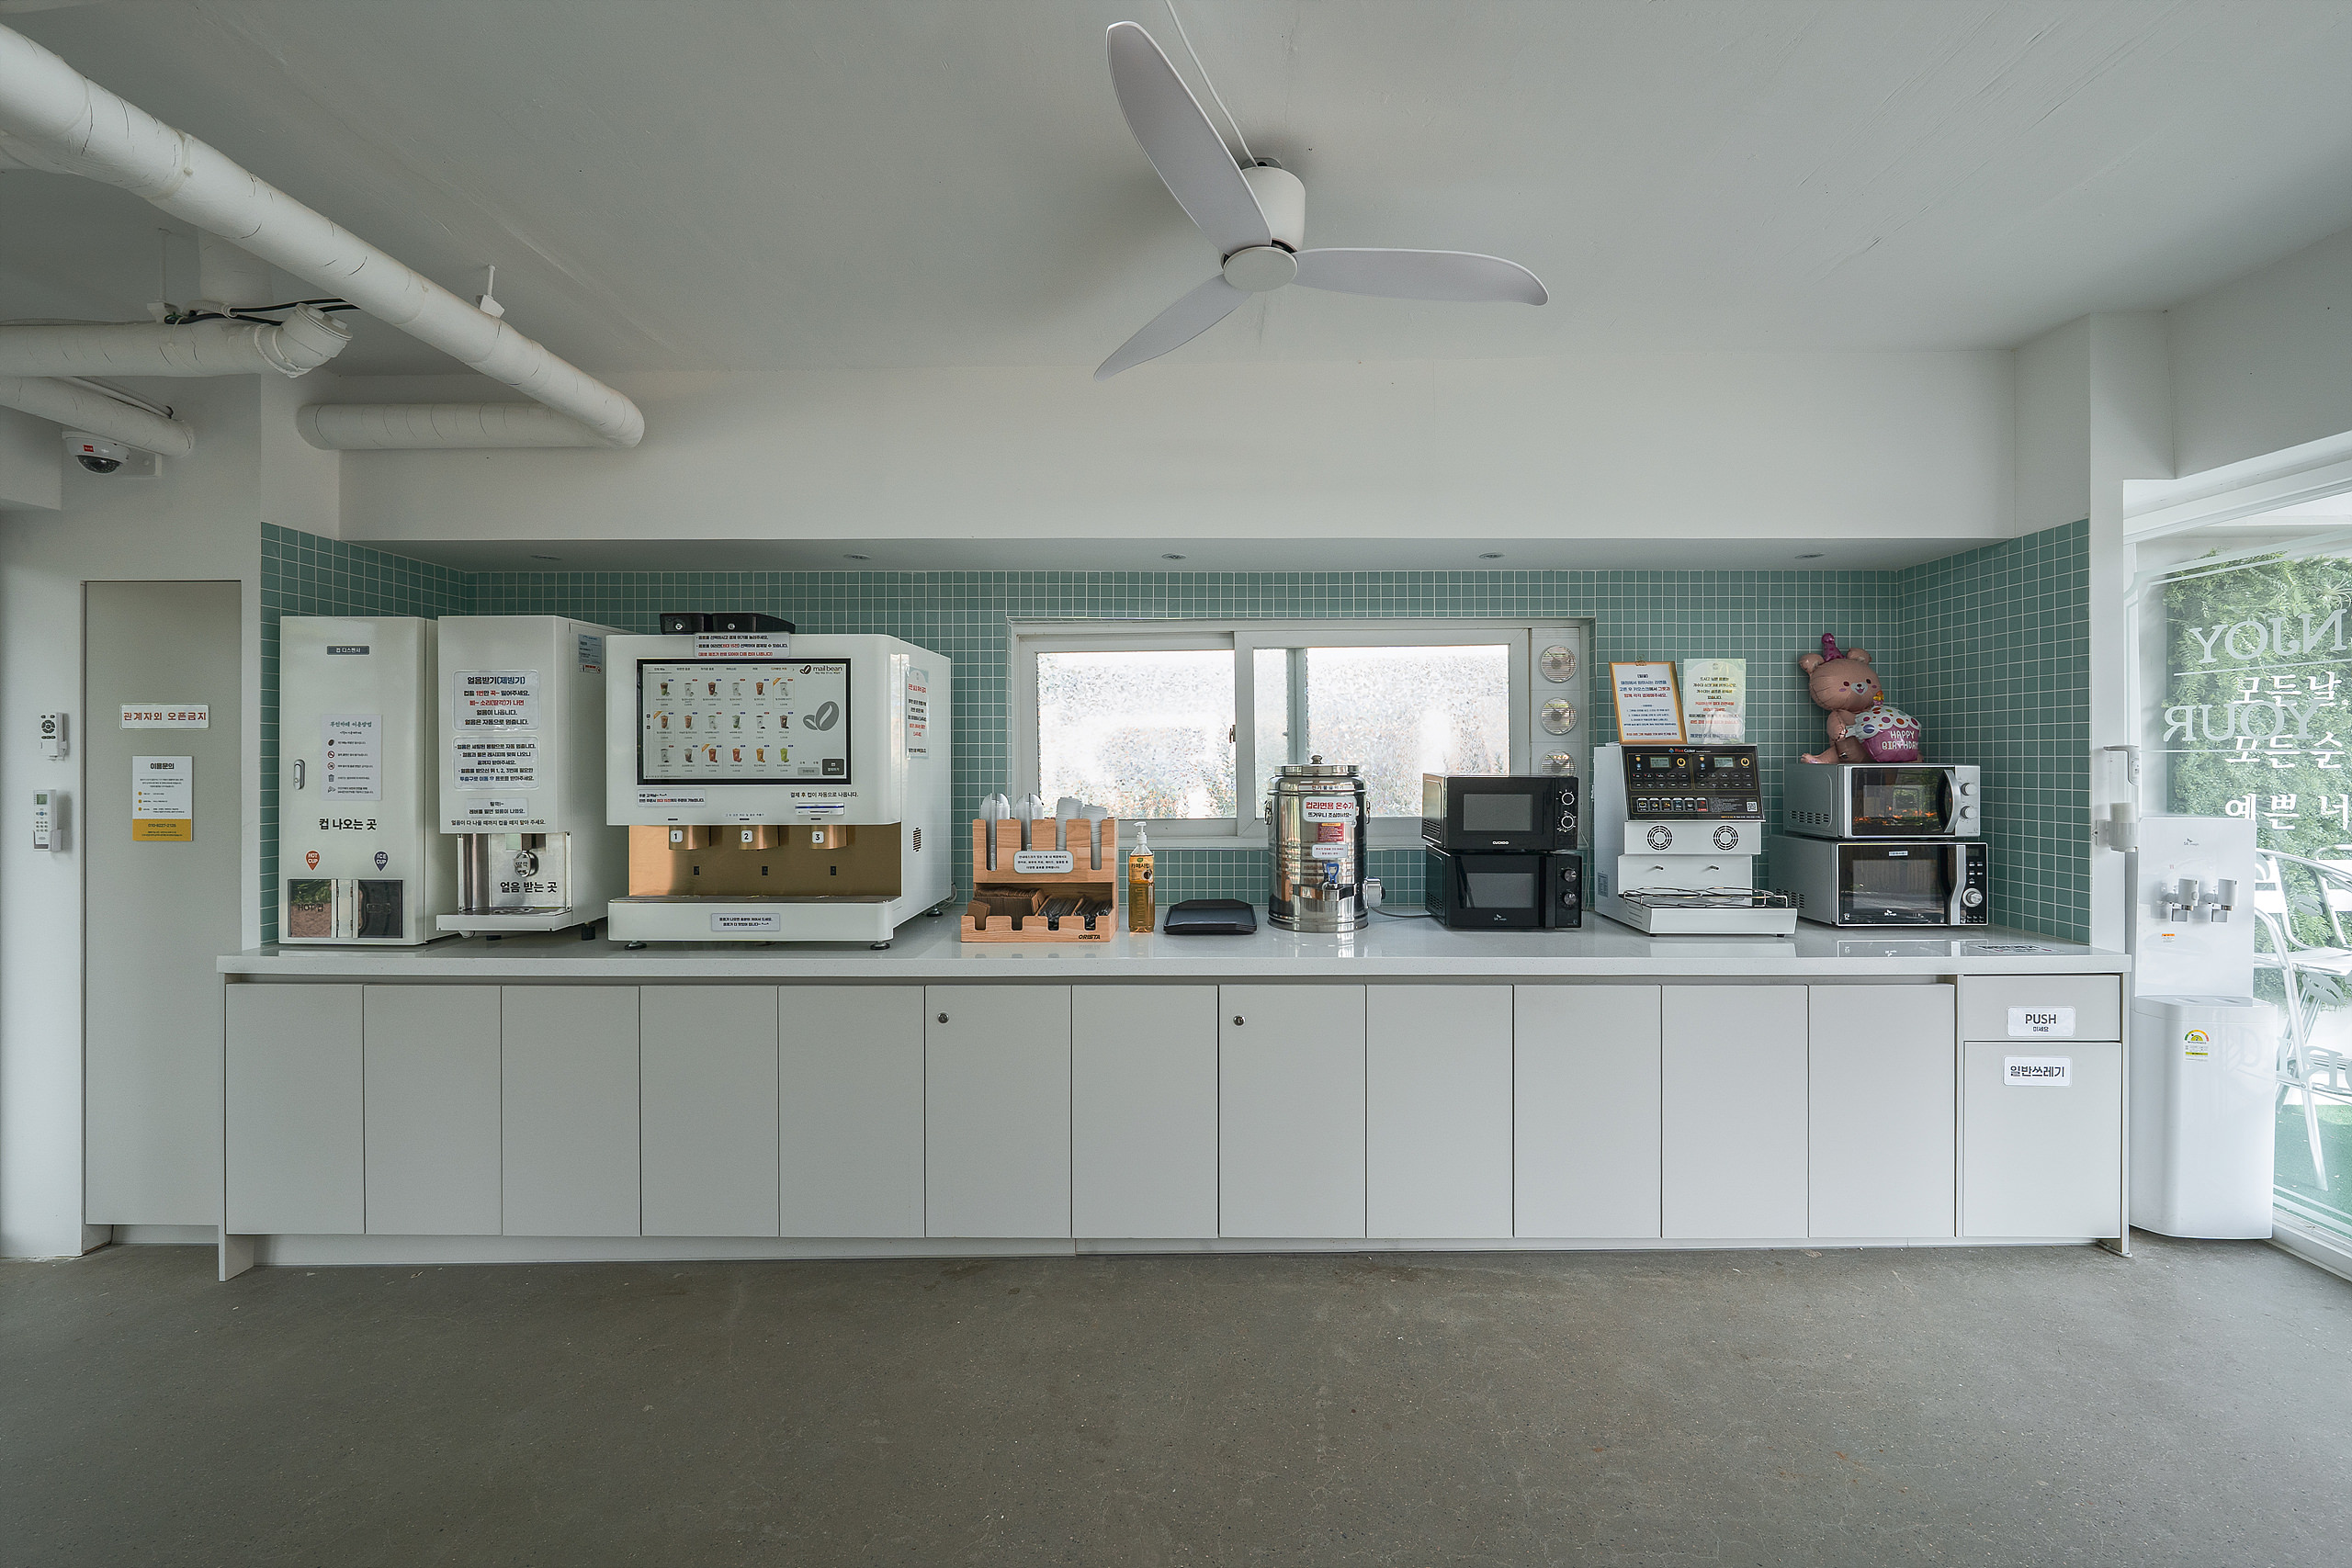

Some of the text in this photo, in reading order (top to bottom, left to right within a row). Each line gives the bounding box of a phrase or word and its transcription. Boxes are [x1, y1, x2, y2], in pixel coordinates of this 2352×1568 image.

[1882, 741, 1918, 750] BIRTHDAY
[319, 818, 377, 829] 컵 나오는 곳
[500, 882, 557, 893] 얼음 받는 곳
[2025, 1014, 2056, 1024] PUSH
[2010, 1066, 2064, 1077] 일반쓰레기
